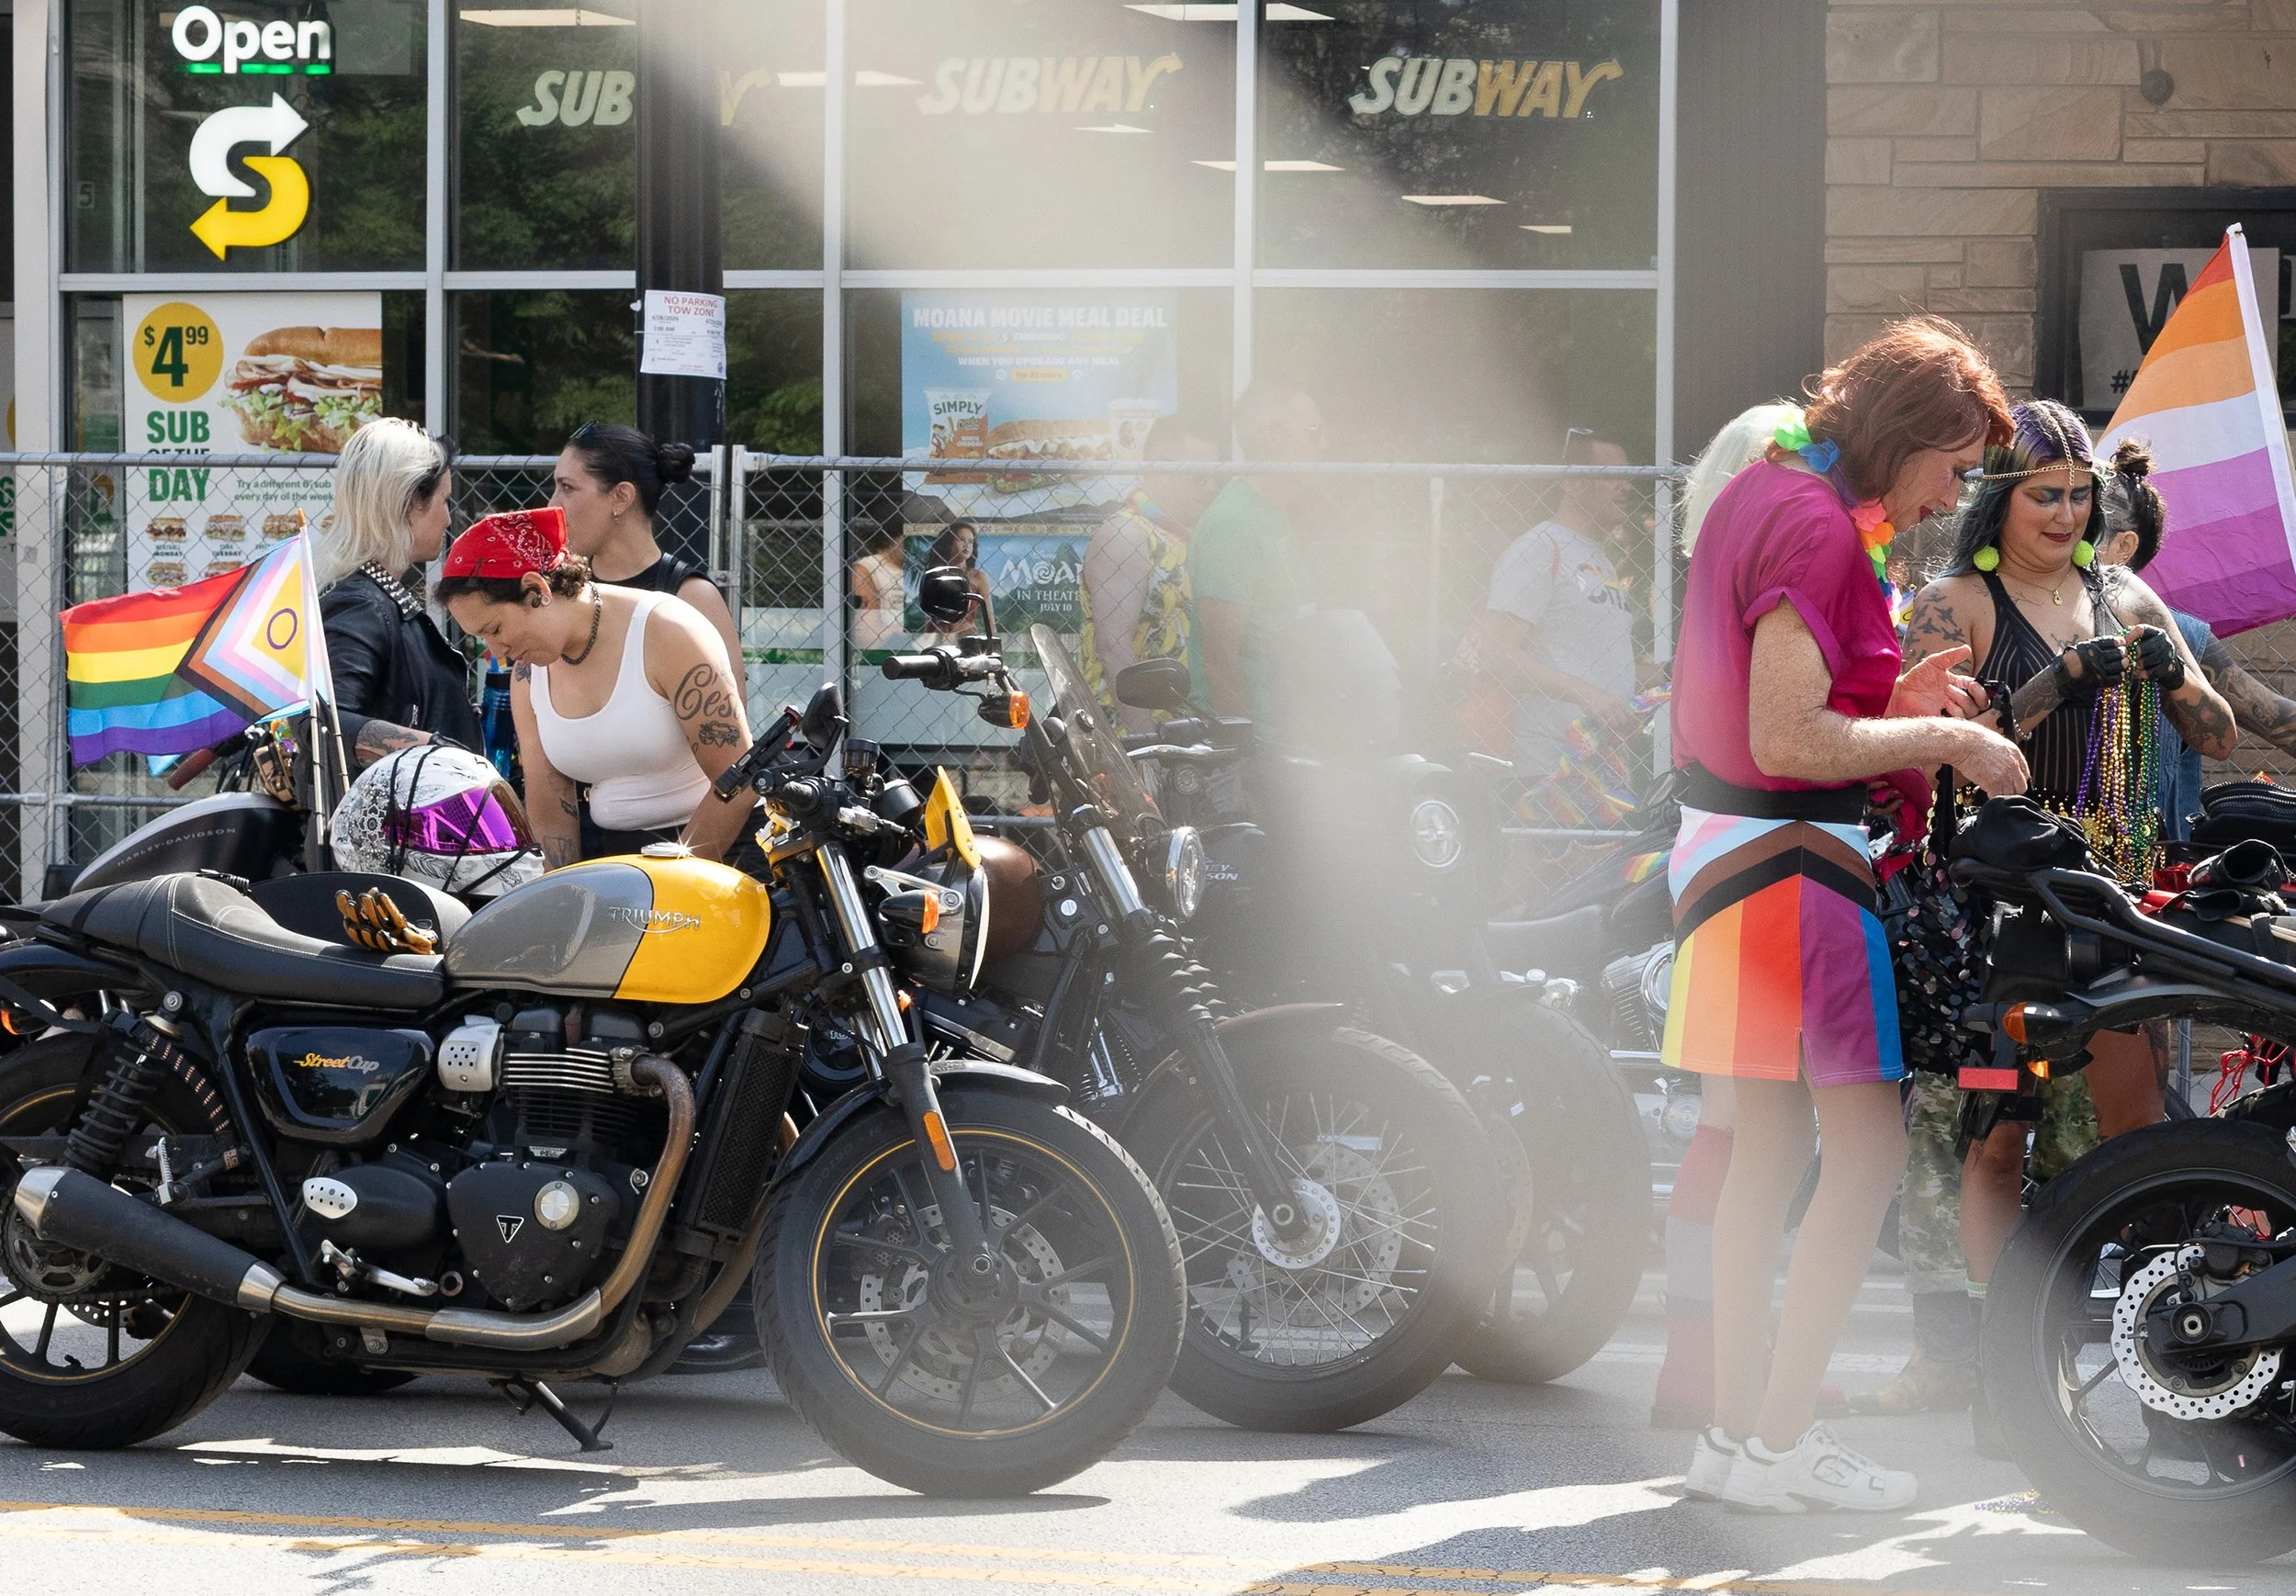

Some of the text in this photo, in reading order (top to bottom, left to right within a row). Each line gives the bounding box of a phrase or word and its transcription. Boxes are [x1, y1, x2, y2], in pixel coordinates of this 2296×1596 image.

[172, 5, 332, 73] Open
[919, 51, 1183, 116] SUBWAY
[1348, 57, 1624, 118] SUBWAY
[664, 297, 718, 309] NO PARKING
[669, 306, 715, 317] TOW ZONE
[914, 308, 1167, 328] MOANA MOVIE MEAL DEAL
[958, 356, 989, 365] WHEN
[992, 356, 1012, 365] YOU
[1066, 356, 1088, 365] ANY
[1090, 356, 1120, 365] MEAL
[933, 400, 983, 415] SIMPLY
[147, 411, 209, 444] SUB
[149, 468, 210, 501] DAY
[237, 479, 253, 489] Try
[260, 479, 301, 489] different
[314, 479, 332, 489] sub
[263, 492, 278, 501] day
[280, 492, 290, 500] of
[291, 492, 308, 500] the
[309, 492, 333, 500] week
[1018, 590, 1030, 601] IN
[1041, 603, 1072, 612] JULY 10
[118, 827, 236, 867] HARLEY-DAVIDSON
[609, 906, 701, 932] TRIUMPH
